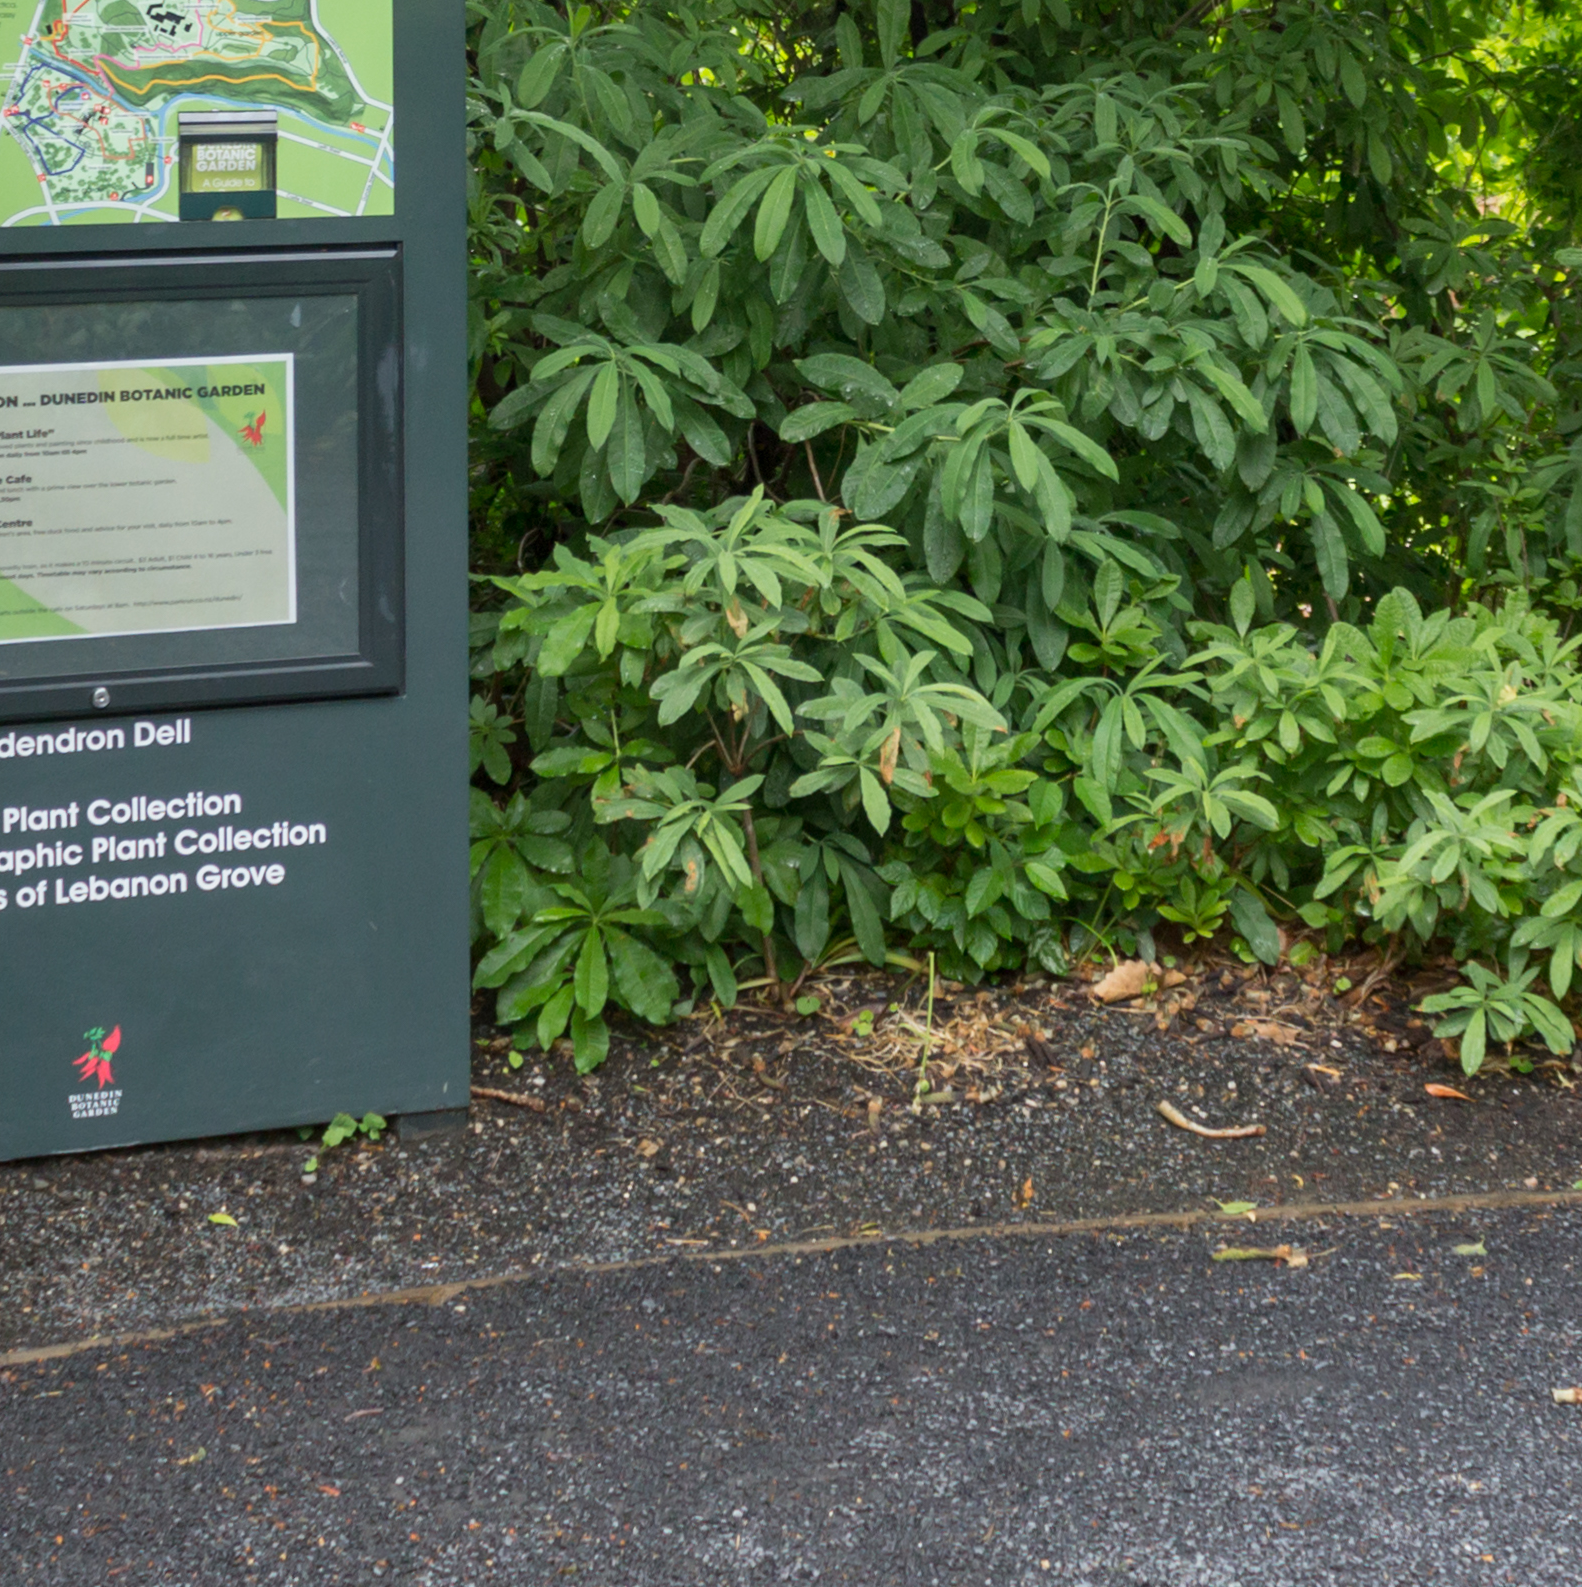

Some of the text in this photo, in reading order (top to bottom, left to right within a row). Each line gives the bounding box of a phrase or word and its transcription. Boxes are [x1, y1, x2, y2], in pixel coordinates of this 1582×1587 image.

[197, 149, 256, 160] BOTANIC
[196, 160, 256, 172] GARDEN
[203, 178, 255, 188] A Guide to
[40, 391, 115, 406] DUNEDIN
[120, 387, 193, 402] BOTANIC
[197, 384, 266, 398] GARDEN
[6, 451, 22, 459] daily
[6, 474, 32, 484] Cafe
[134, 718, 191, 747] Dell
[3, 802, 79, 834] Plant
[87, 791, 241, 826] Collection
[92, 832, 167, 863] Plant
[174, 821, 326, 855] Collection
[15, 880, 47, 908] of
[55, 872, 187, 904] Lebanon
[196, 864, 285, 890] Grove
[68, 1090, 123, 1103] DUNEDIN
[71, 1098, 120, 1111] BOTANIC
[73, 1107, 118, 1118] GARDEN
